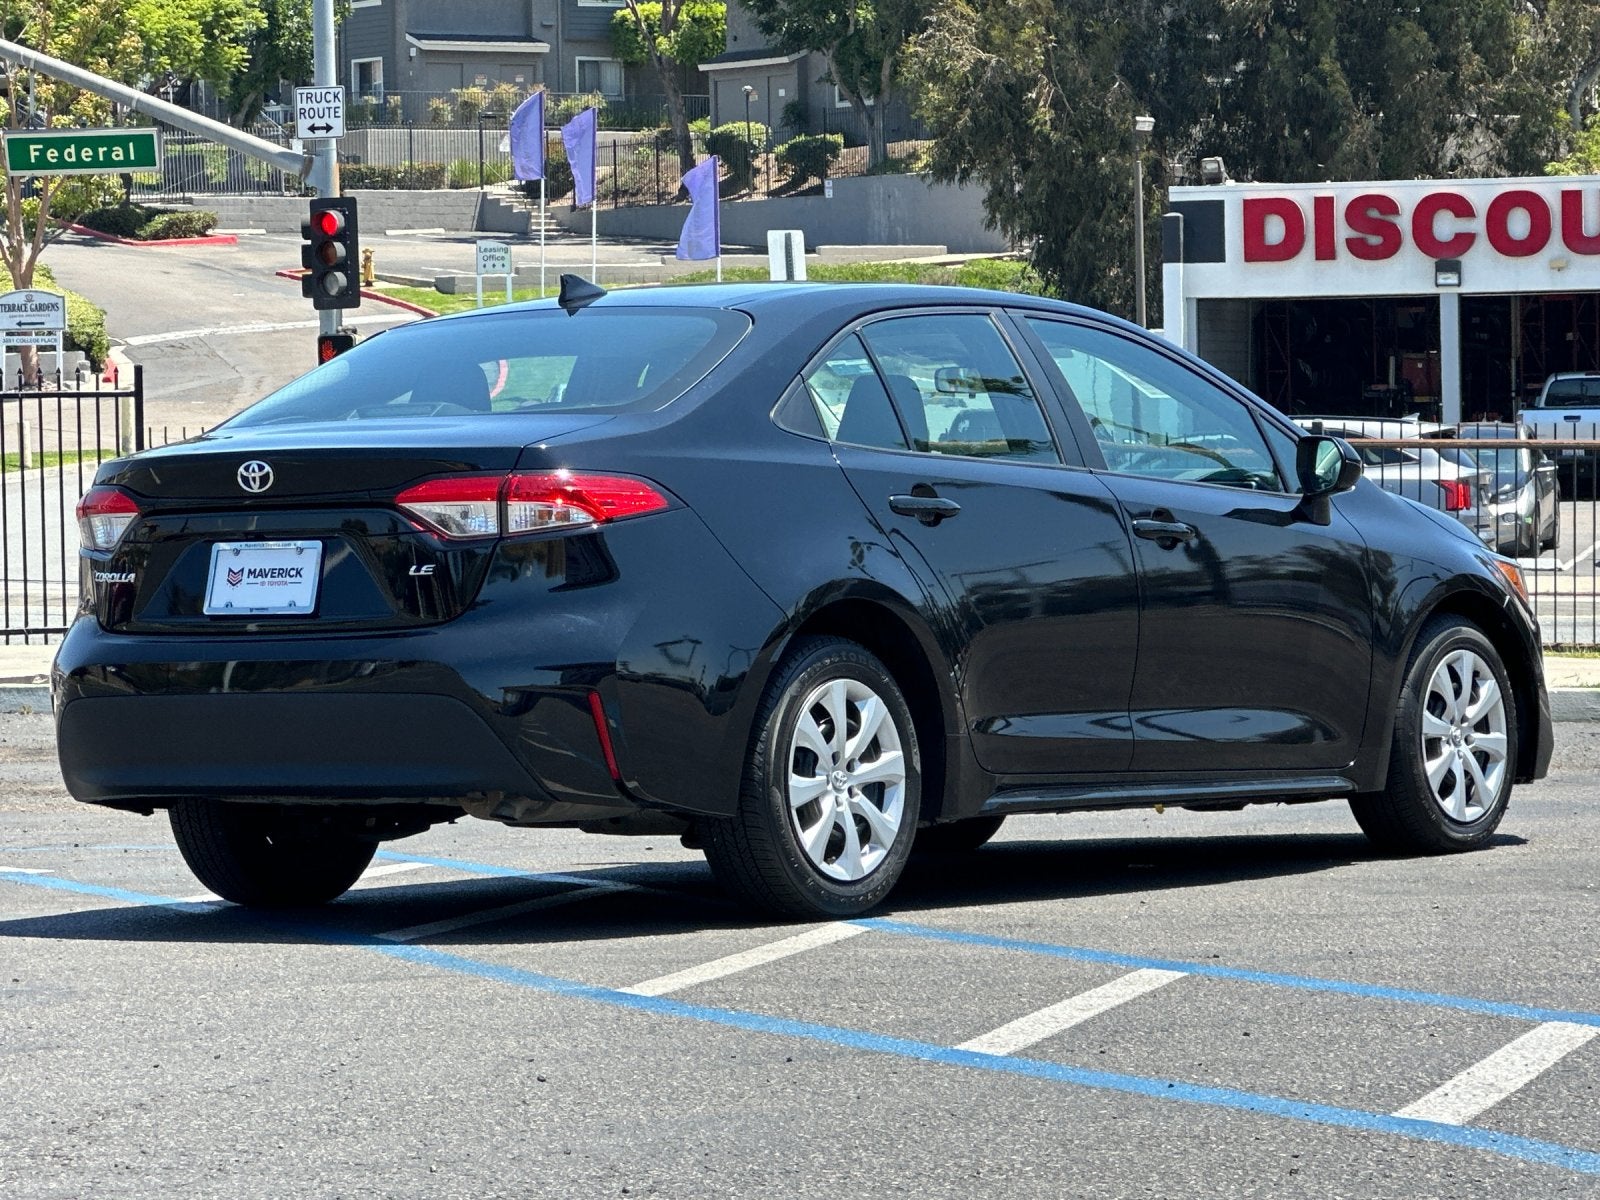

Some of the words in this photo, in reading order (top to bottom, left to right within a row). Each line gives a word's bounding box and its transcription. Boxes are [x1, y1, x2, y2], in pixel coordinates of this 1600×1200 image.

[298, 91, 341, 105] TRUCK
[298, 106, 341, 120] ROUTE
[29, 142, 135, 163] Federal
[1243, 189, 1600, 263] DISCOU
[478, 245, 509, 254] Leasing
[482, 254, 506, 262] Office
[0, 303, 28, 312] TERRACE
[30, 302, 60, 311] GARDENS
[247, 567, 303, 578] MAVERICK
[408, 564, 437, 576] LE
